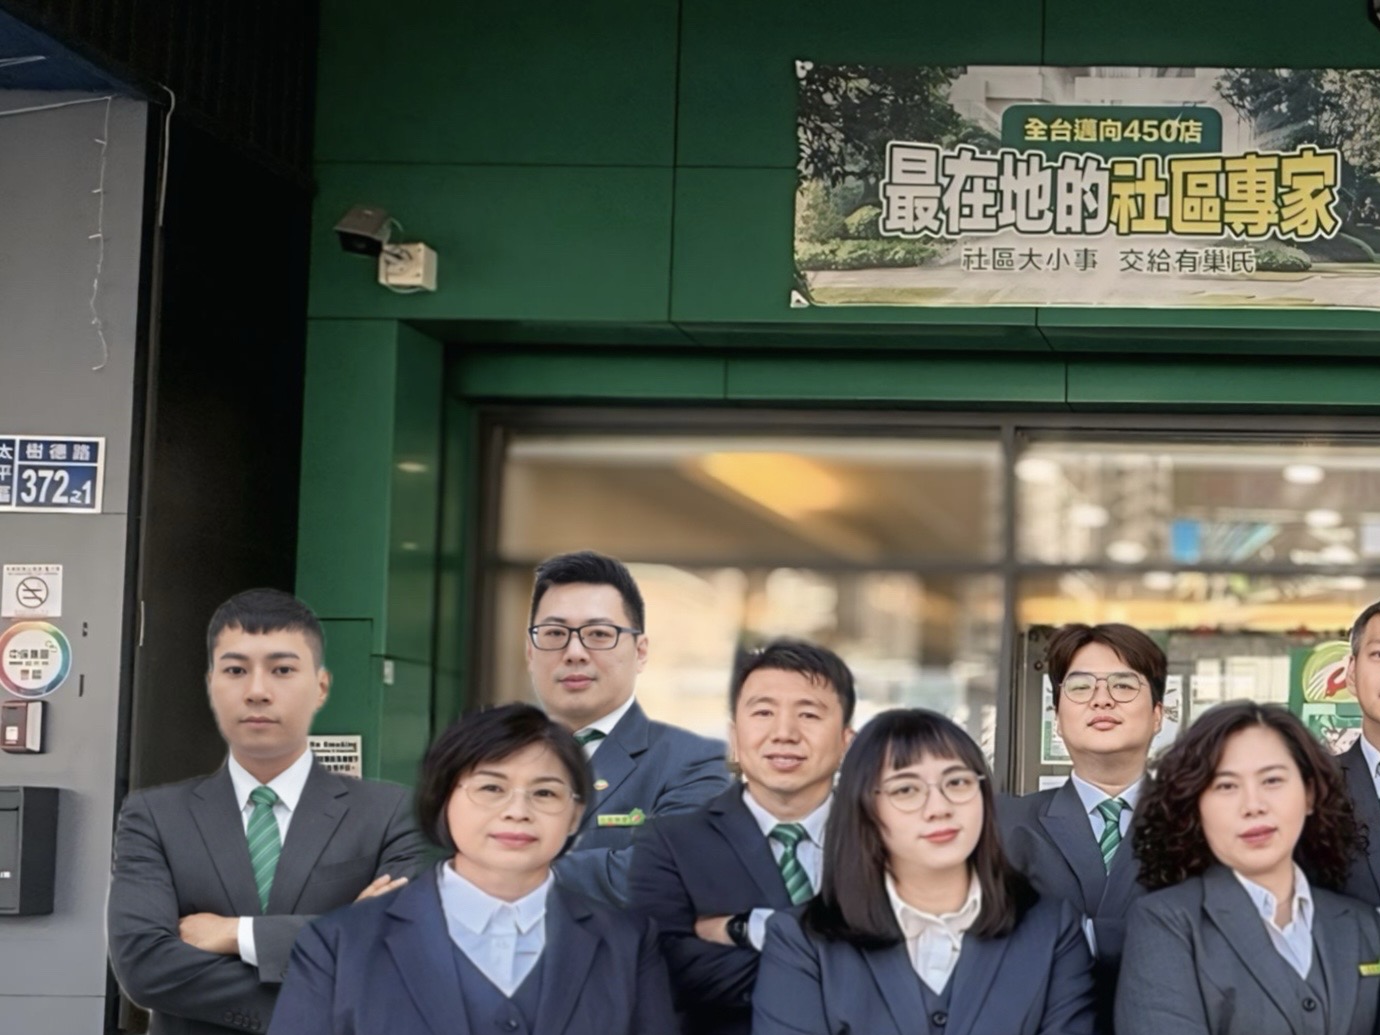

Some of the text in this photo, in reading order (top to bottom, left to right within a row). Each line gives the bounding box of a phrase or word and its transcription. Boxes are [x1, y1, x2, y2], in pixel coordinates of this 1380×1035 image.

[1024, 117, 1203, 143] 全台邁向450店
[882, 143, 1340, 239] 最在地的社區專家
[962, 247, 1256, 273] 社區大小事 交給有巢氏
